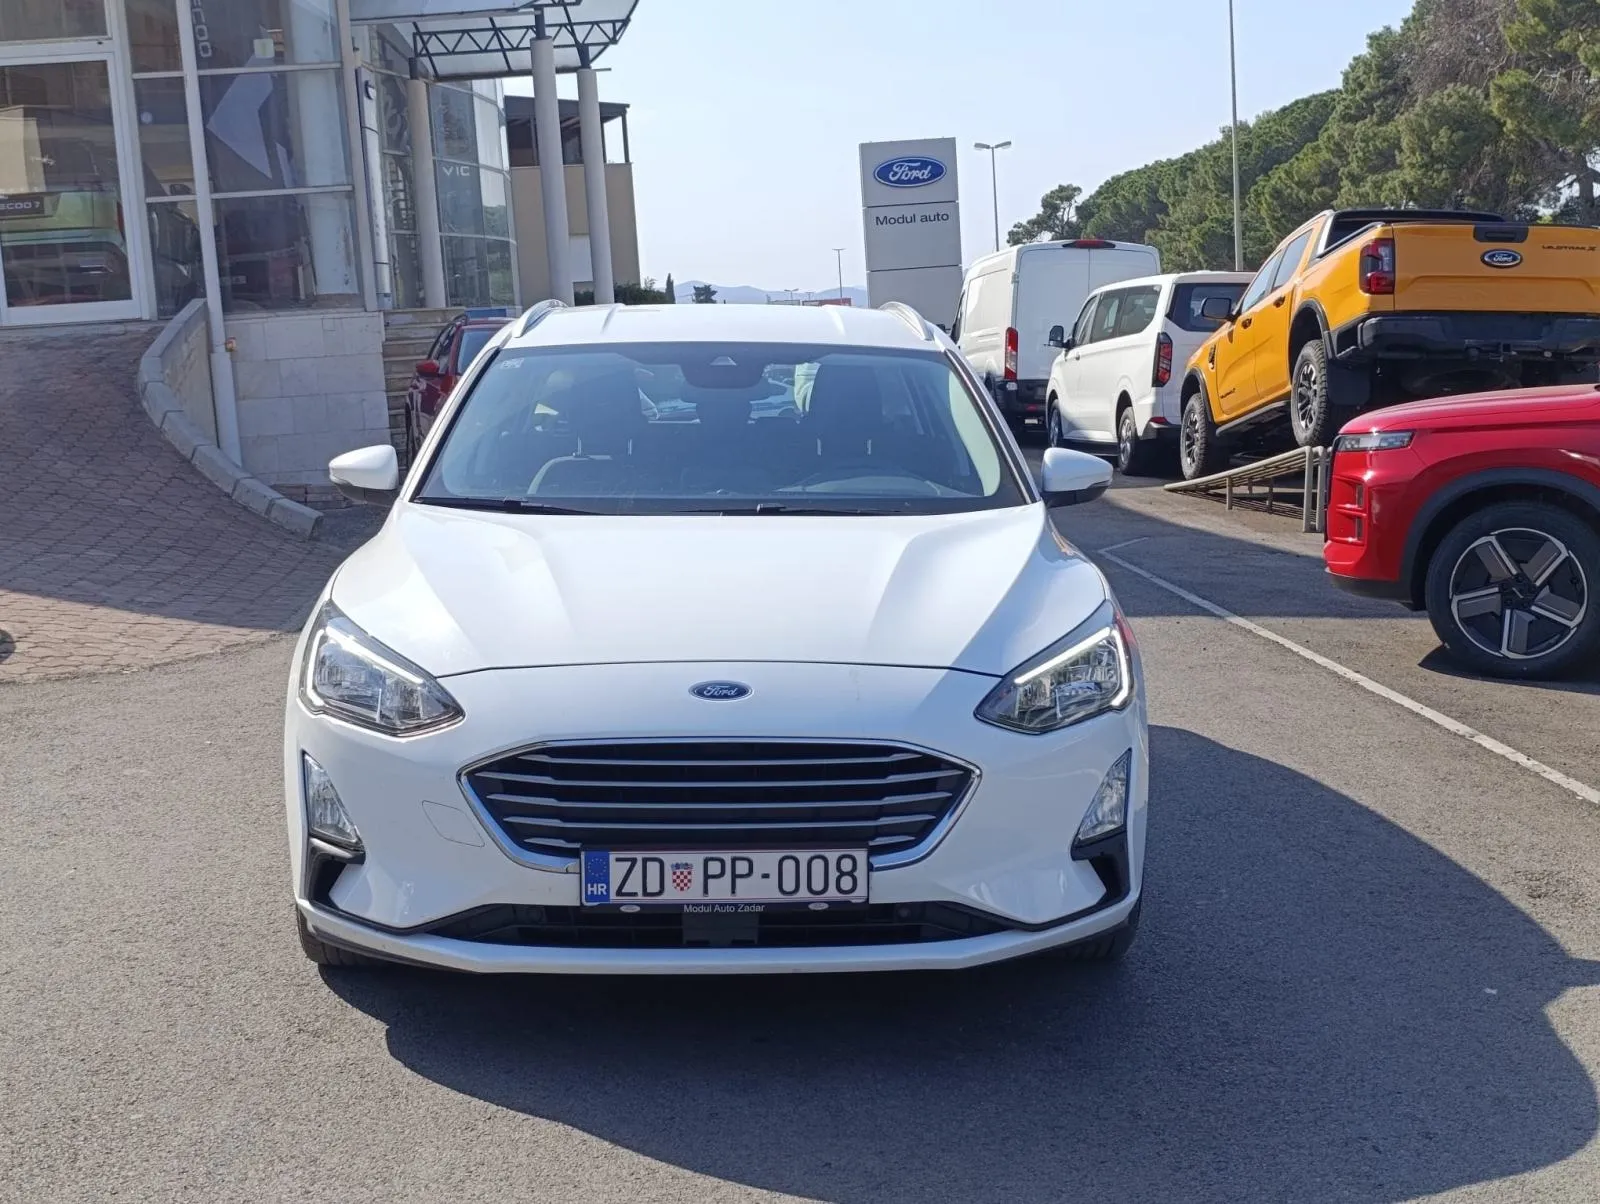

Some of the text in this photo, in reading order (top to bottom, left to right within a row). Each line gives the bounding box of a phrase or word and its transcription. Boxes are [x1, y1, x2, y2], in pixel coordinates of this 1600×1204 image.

[889, 162, 932, 181] Ford
[875, 212, 950, 226] Modul auto
[703, 684, 738, 696] Ford
[615, 854, 858, 897] ZD PP-008
[587, 883, 607, 896] HR
[683, 903, 765, 913] Modul Auto Zadar
